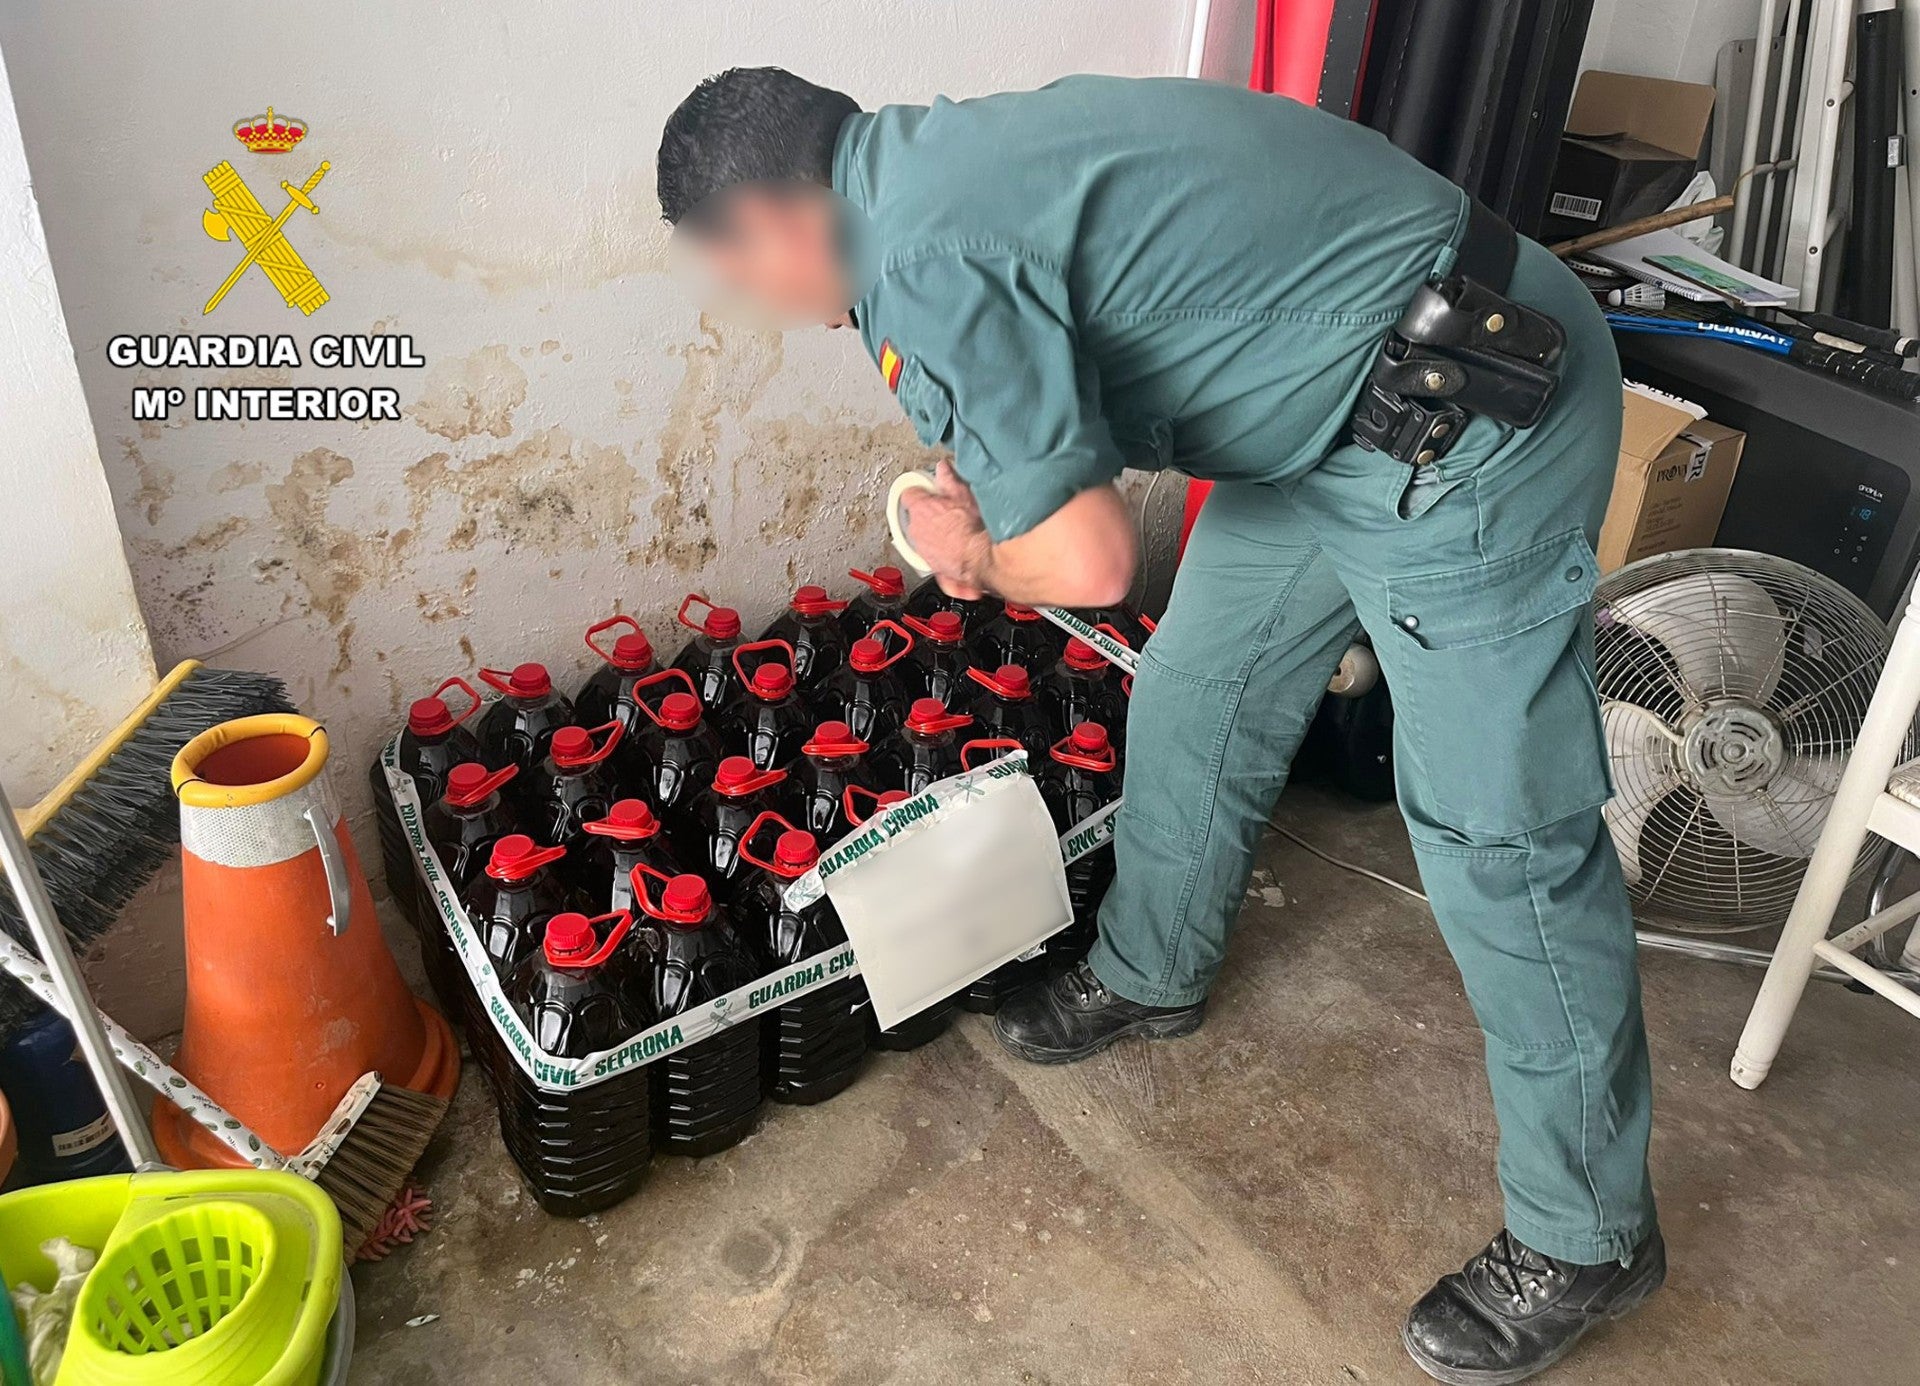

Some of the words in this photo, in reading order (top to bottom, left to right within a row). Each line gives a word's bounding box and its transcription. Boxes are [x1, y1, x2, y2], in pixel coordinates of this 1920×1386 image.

[748, 962, 825, 1009] GUARDIA
[828, 949, 858, 974] CIV
[594, 1024, 684, 1077] SEPRONA
